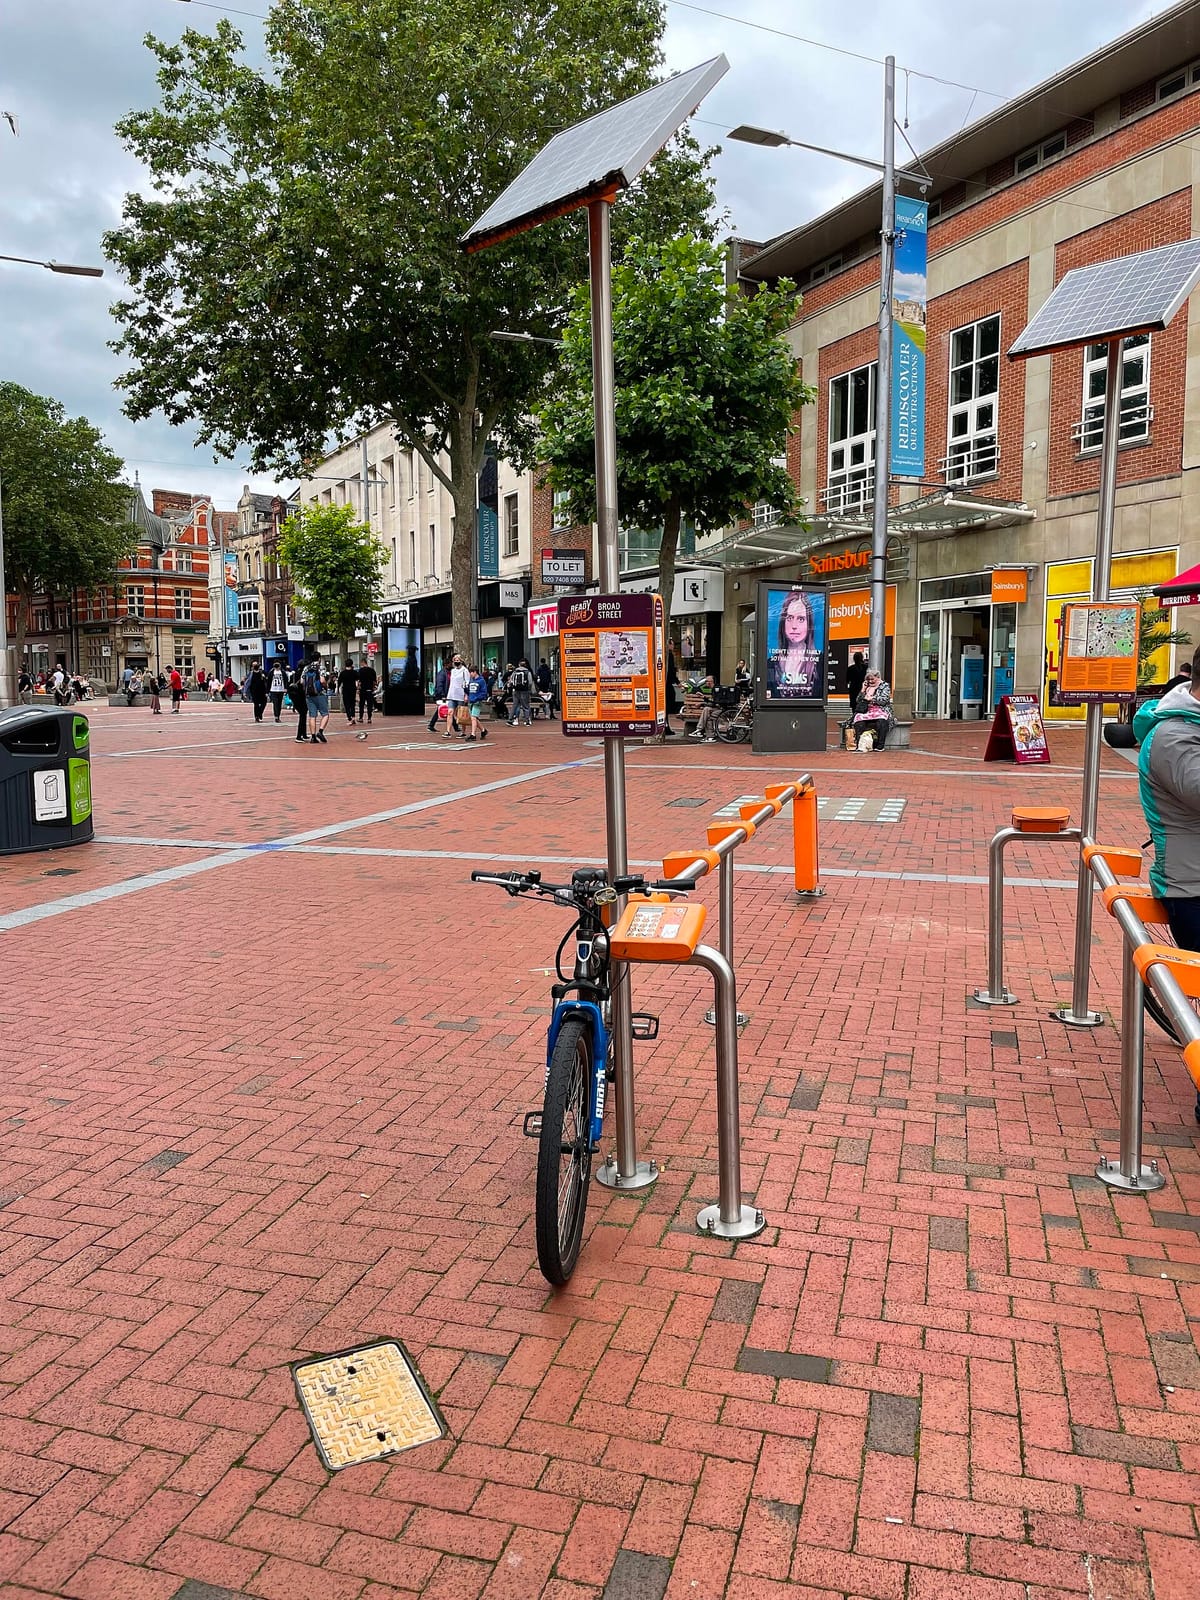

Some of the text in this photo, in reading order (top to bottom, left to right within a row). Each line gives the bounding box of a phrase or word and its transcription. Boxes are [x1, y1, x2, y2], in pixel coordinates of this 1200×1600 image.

[899, 342, 910, 450] REDISCOVER
[910, 353, 919, 432] ATTRACTIONS
[482, 510, 490, 563] REDISCOVER
[546, 562, 580, 572] TO LET
[993, 581, 1024, 592] Sainsbury's
[504, 590, 519, 598] M&S
[570, 598, 592, 614] READY
[598, 602, 621, 610] BROAD
[1162, 595, 1191, 606] BURRITOS
[378, 610, 408, 627] SPENCER
[598, 610, 622, 620] STREET
[1008, 696, 1034, 704] TORTILLA
[595, 1067, 606, 1119] spark
